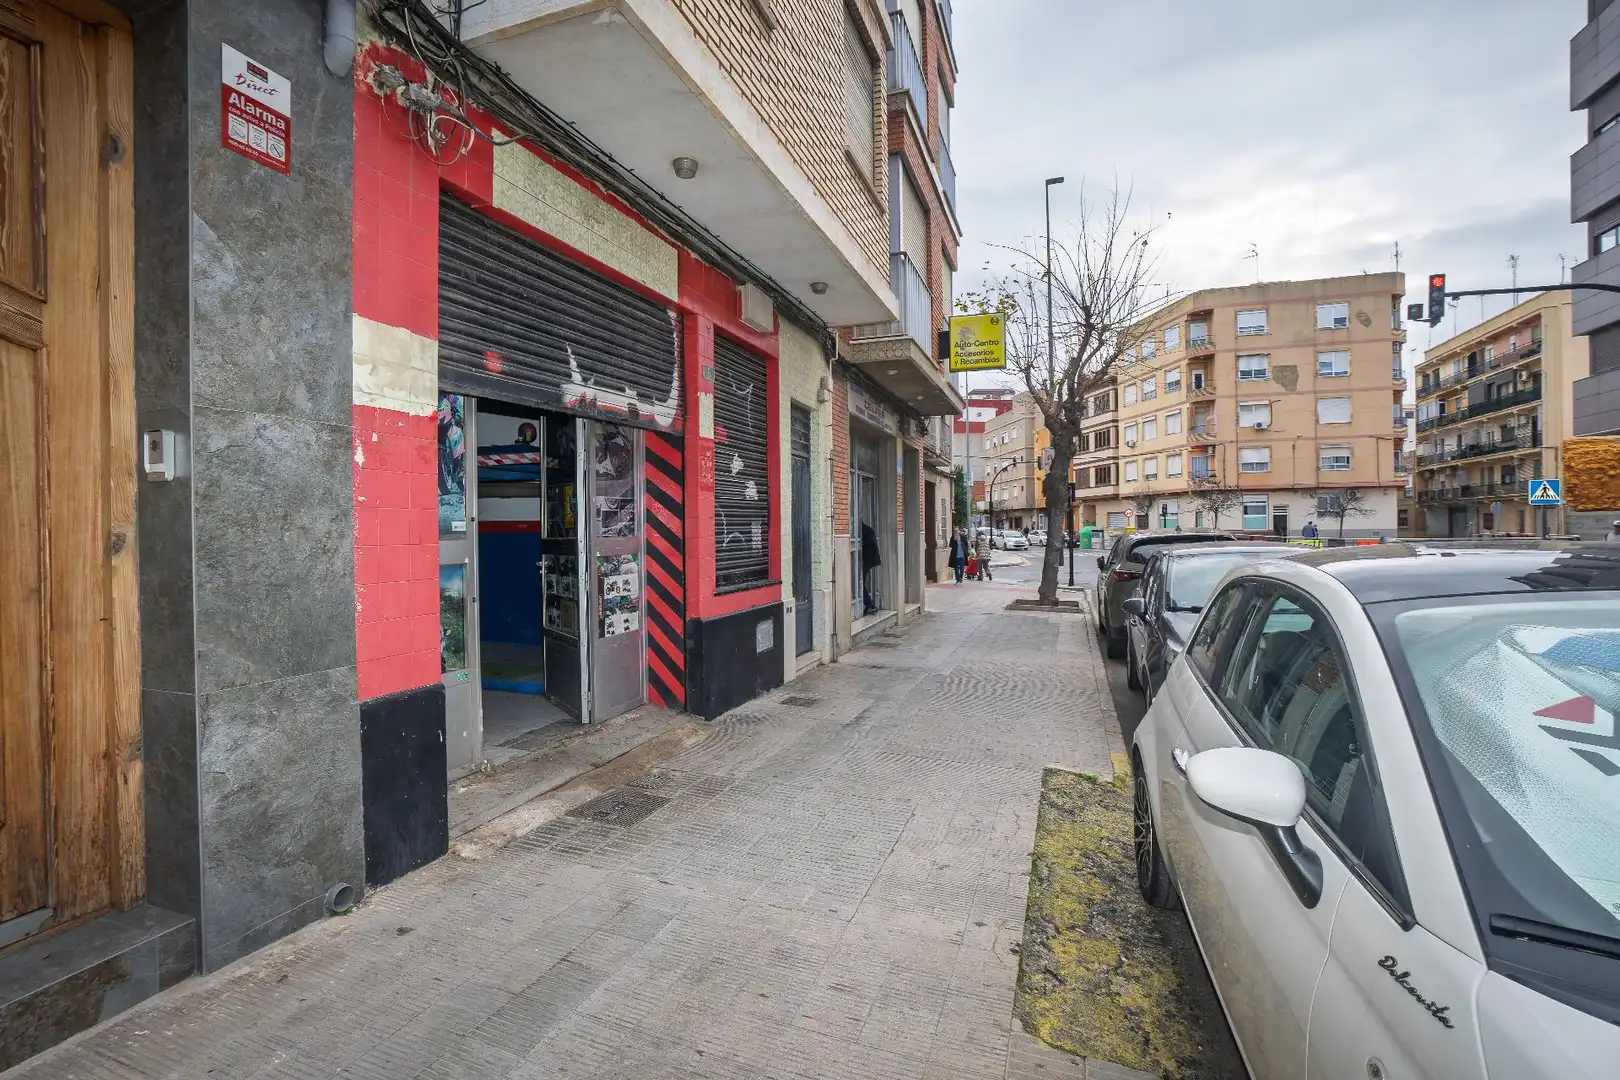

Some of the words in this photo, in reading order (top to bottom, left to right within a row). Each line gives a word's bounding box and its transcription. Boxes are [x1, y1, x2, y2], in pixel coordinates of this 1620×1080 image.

[235, 73, 280, 96] Direct
[228, 92, 285, 130] Alarma
[960, 356, 1000, 365] Recambios
[1377, 955, 1455, 1029] Dolcevita
